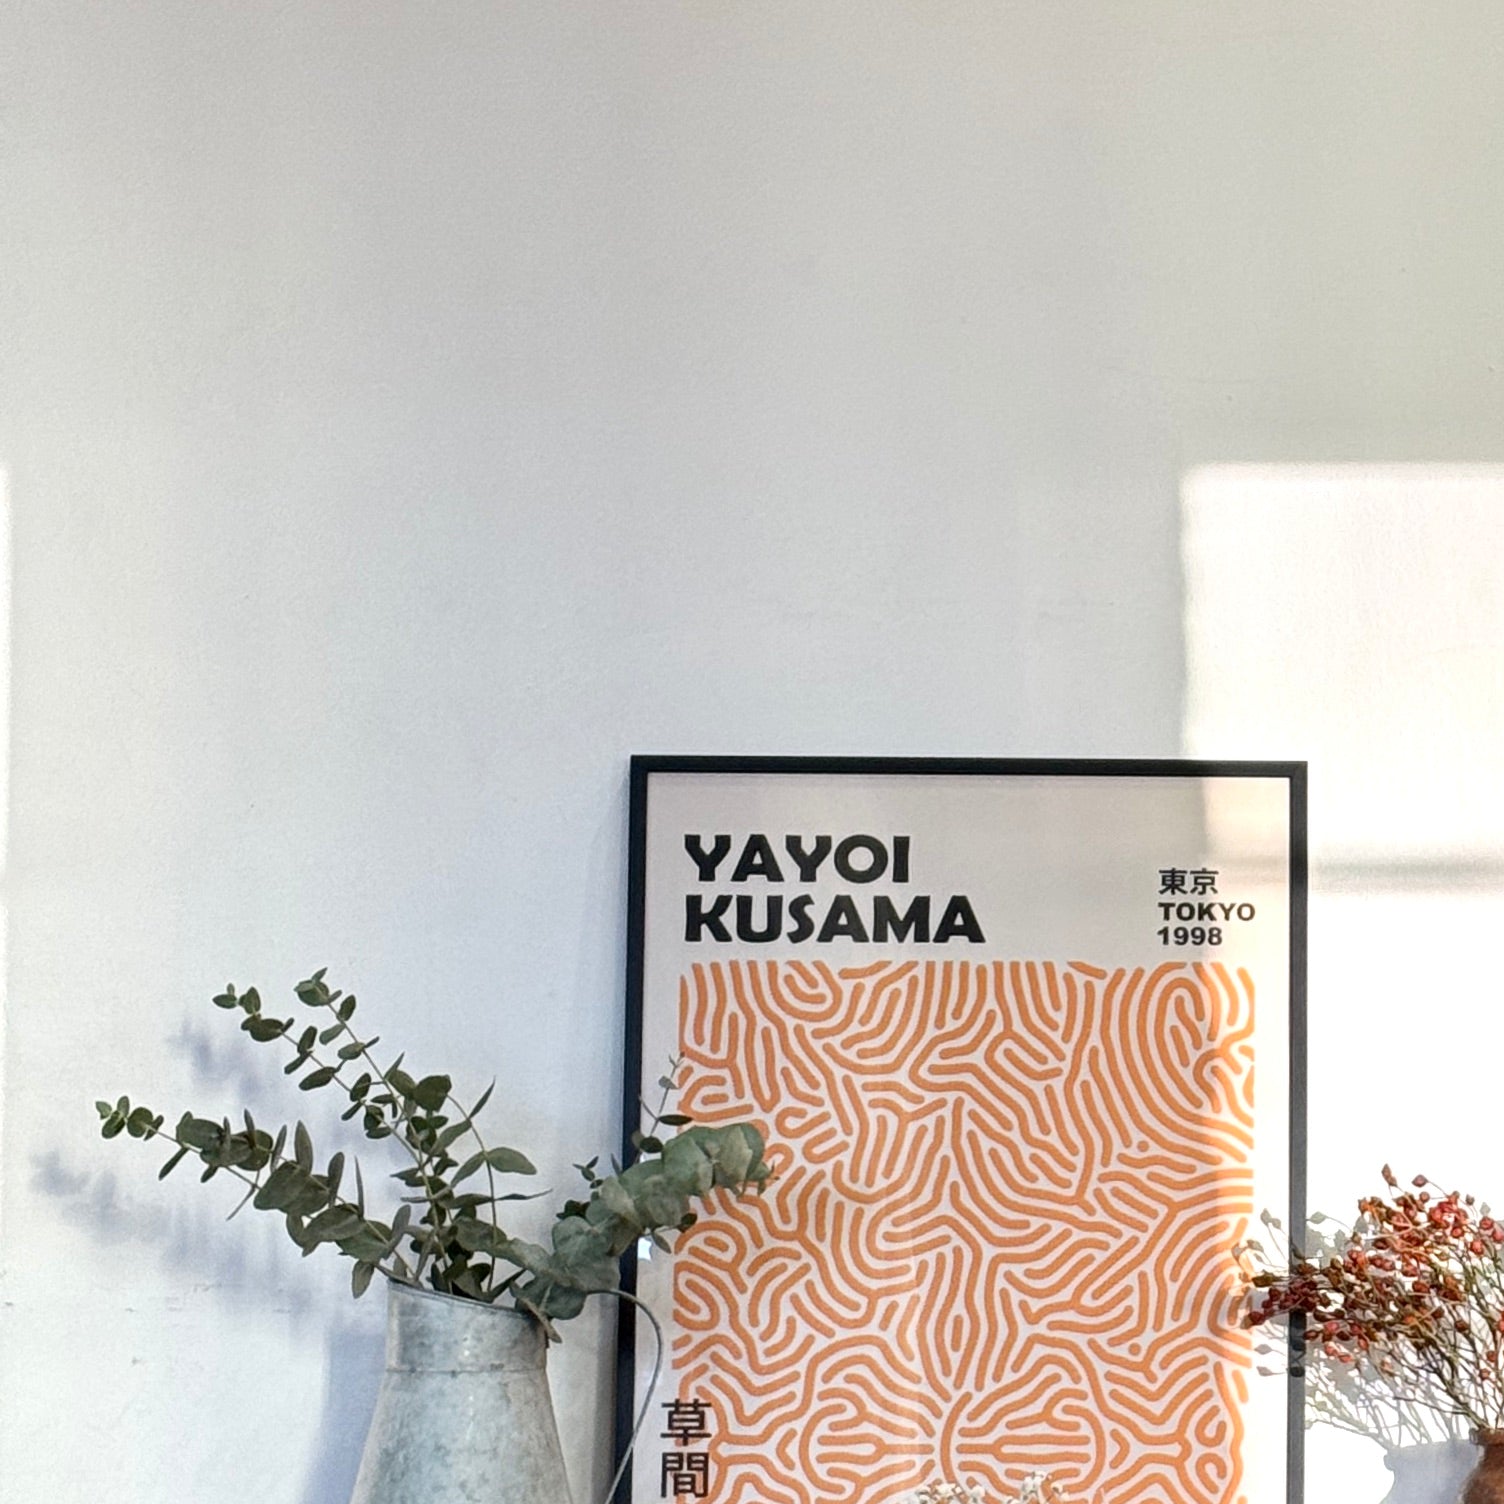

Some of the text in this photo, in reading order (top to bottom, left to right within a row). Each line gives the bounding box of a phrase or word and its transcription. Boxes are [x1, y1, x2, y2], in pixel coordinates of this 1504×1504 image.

[684, 834, 910, 883] YAYOI
[1158, 867, 1219, 896] 東京
[684, 895, 986, 944] KUSAMA
[1158, 902, 1256, 922] TOKYO
[1157, 926, 1223, 946] 1998
